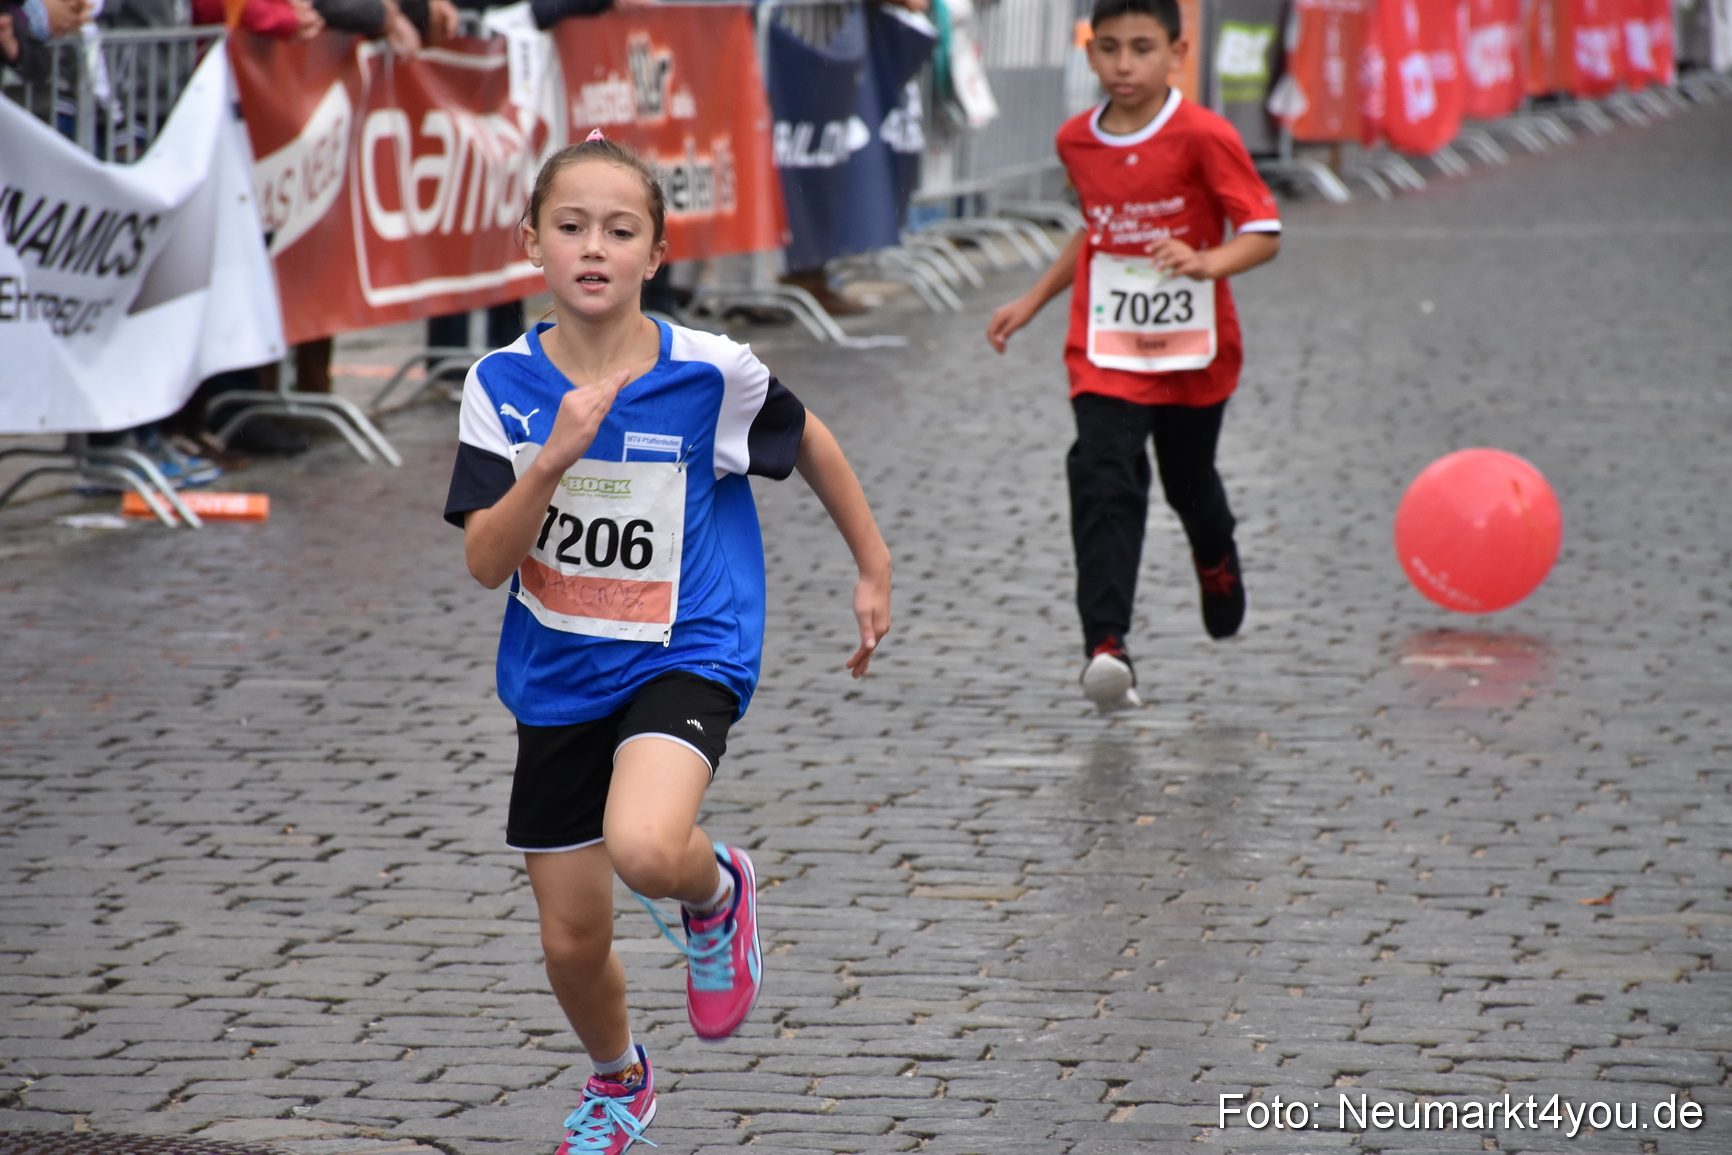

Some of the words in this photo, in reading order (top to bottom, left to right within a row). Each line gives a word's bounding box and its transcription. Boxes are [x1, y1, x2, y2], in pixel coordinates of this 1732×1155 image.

[1110, 290, 1194, 325] 7023
[567, 477, 632, 494] BOCK
[536, 504, 654, 570] 7206
